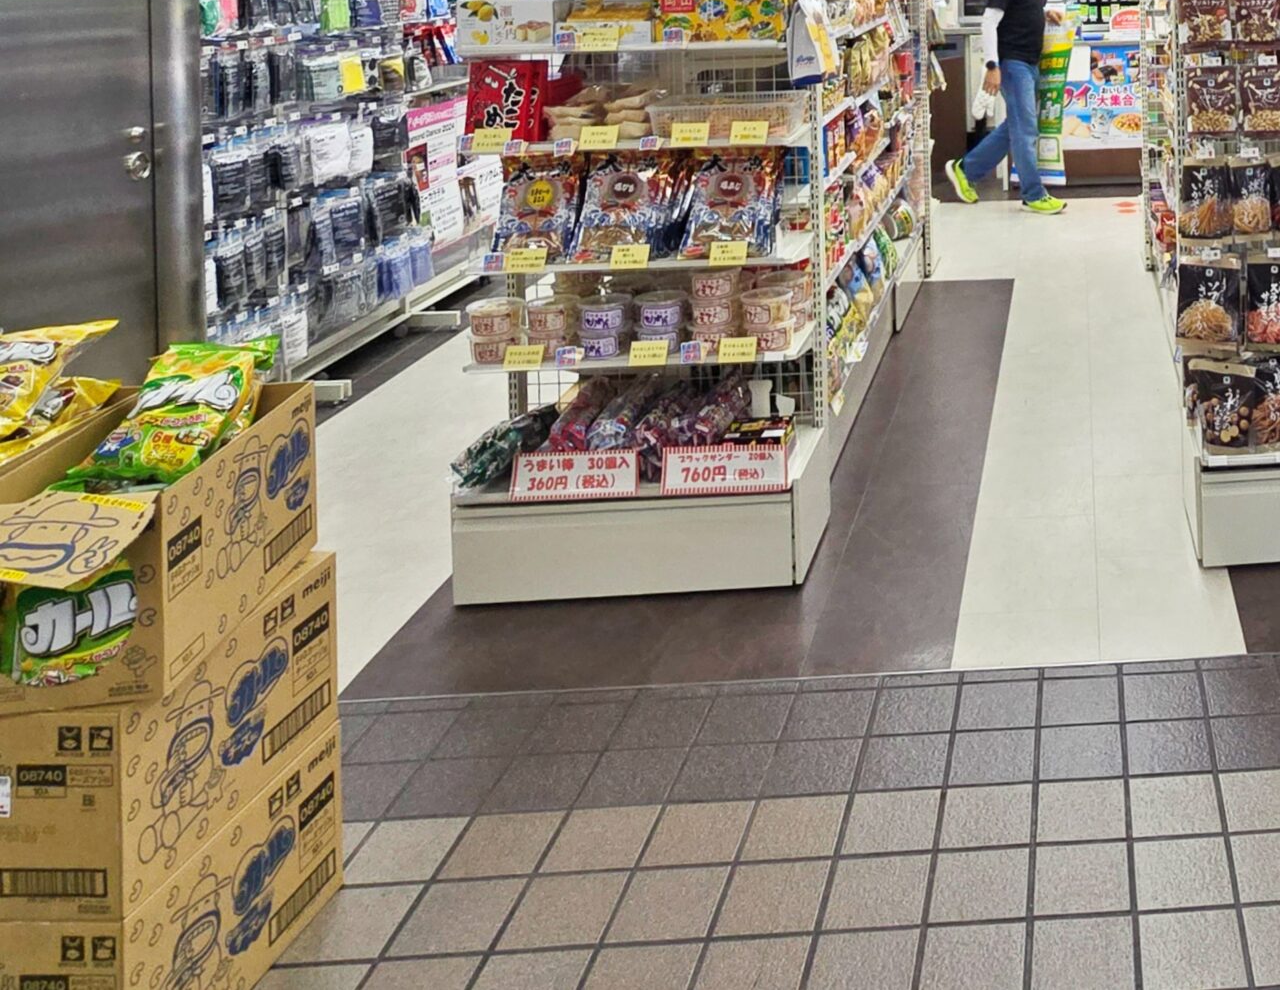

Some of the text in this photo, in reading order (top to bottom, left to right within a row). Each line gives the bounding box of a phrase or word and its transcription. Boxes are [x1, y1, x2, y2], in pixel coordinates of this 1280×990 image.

[1096, 94, 1135, 107] 大集合
[291, 396, 312, 418] meiji
[522, 456, 630, 473] うまい棒 30個入
[679, 453, 741, 464] ブラックサンダー
[527, 472, 616, 491] 360円 （税込）
[681, 465, 728, 484] 760円
[168, 525, 201, 560] 08740
[302, 567, 331, 599] meiji
[19, 579, 138, 656] カール
[294, 610, 329, 647] 08740
[307, 735, 337, 774] meiji
[19, 770, 63, 782] 08740
[300, 780, 335, 822] 08740
[23, 980, 66, 990] 08740
